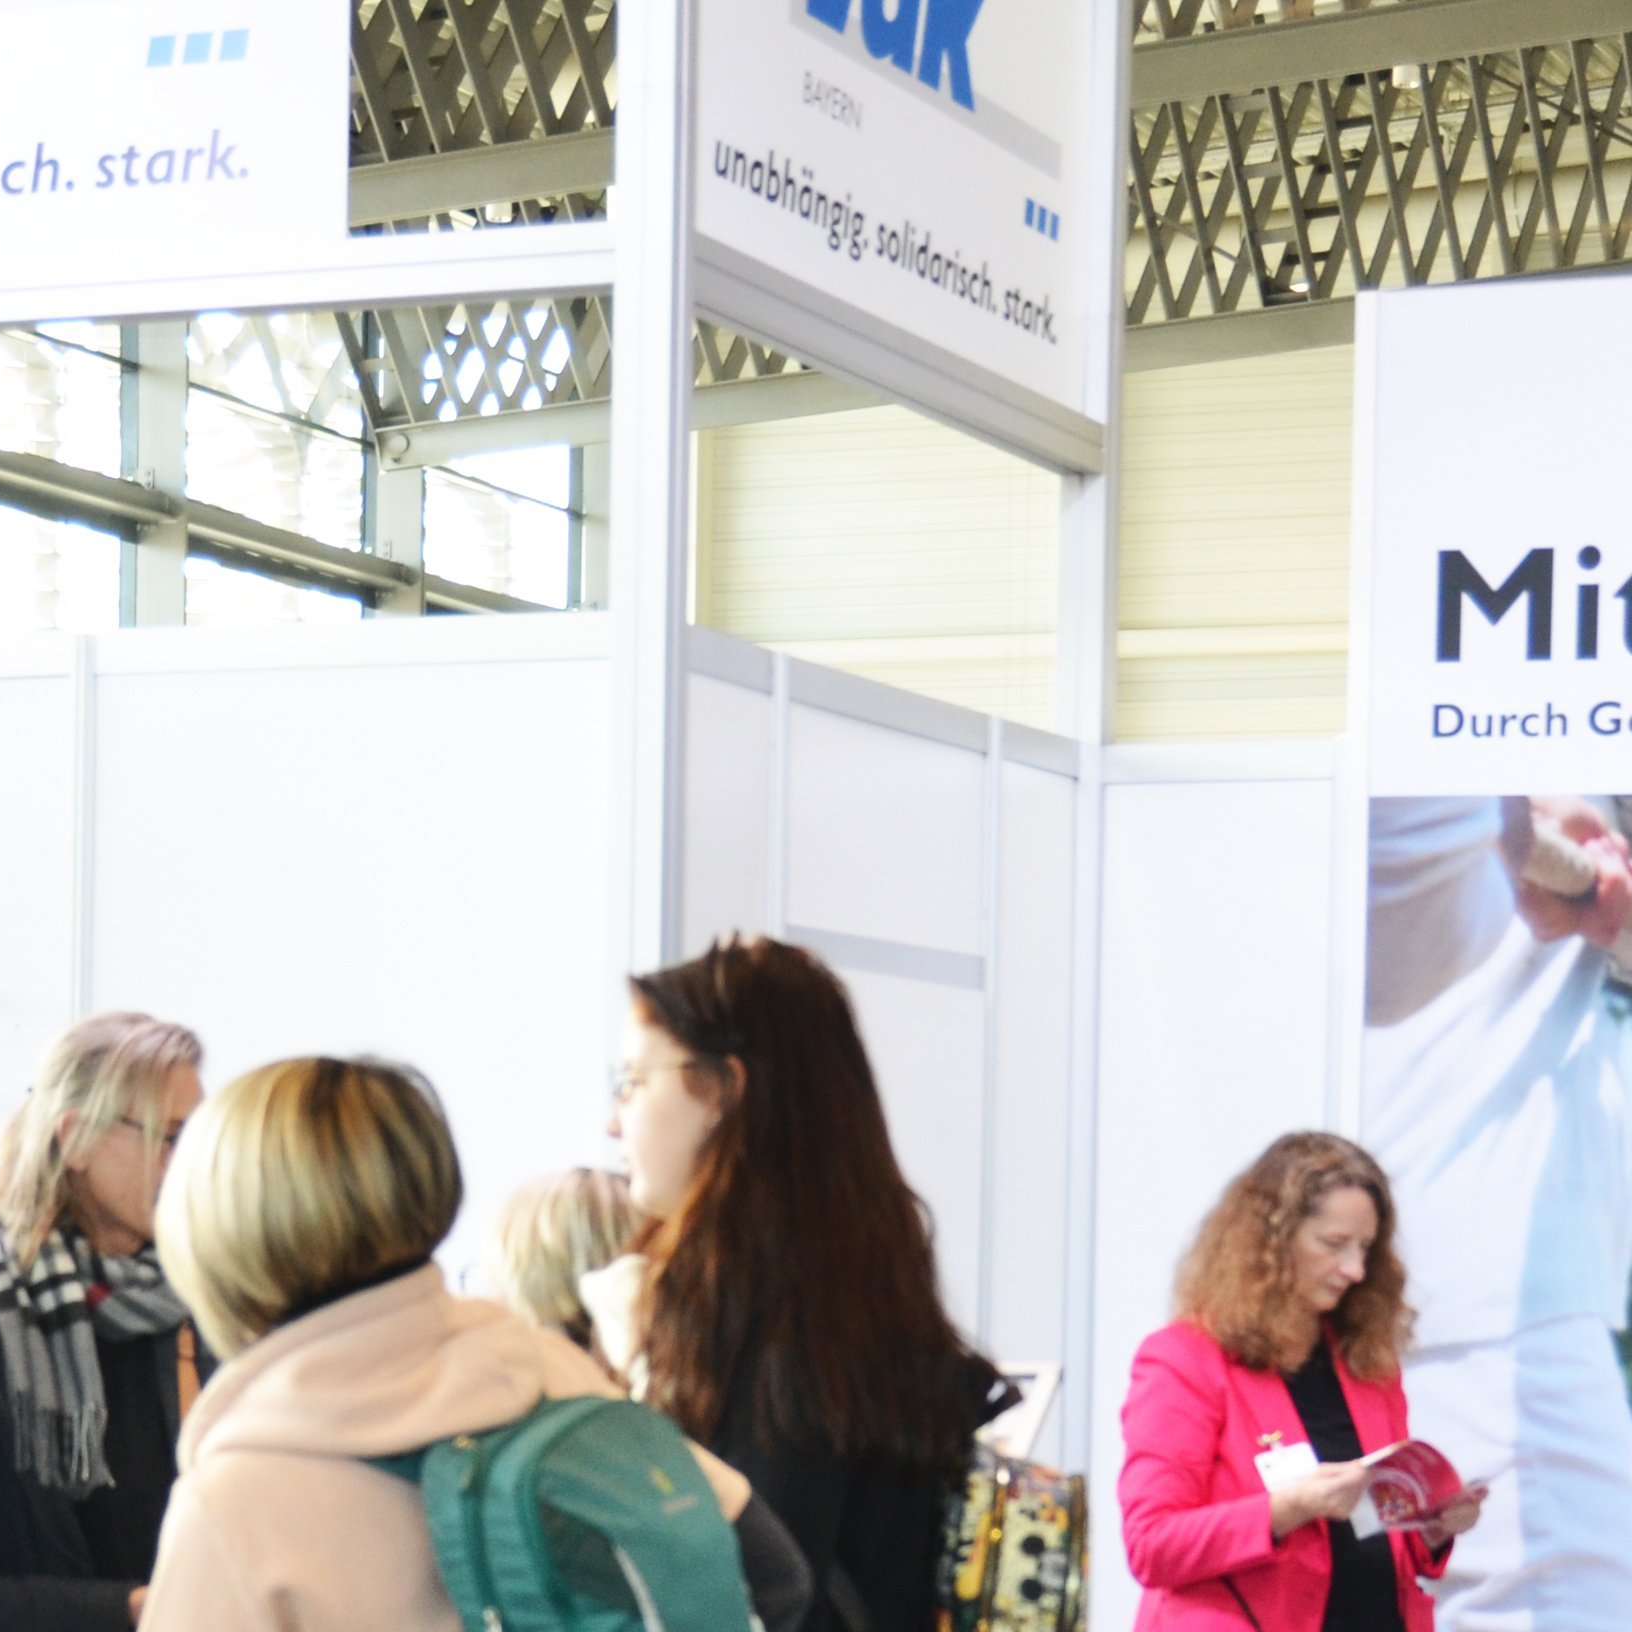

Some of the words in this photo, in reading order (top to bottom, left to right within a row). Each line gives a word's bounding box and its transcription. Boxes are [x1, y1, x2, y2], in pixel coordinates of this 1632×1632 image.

[806, 0, 985, 113] dK
[803, 71, 863, 131] BAYERN
[96, 128, 251, 190] stark.
[714, 140, 869, 261] unabhängig.
[876, 221, 998, 314] solidarisch.
[1003, 287, 1058, 345] stark.
[1430, 702, 1569, 739] Durch
